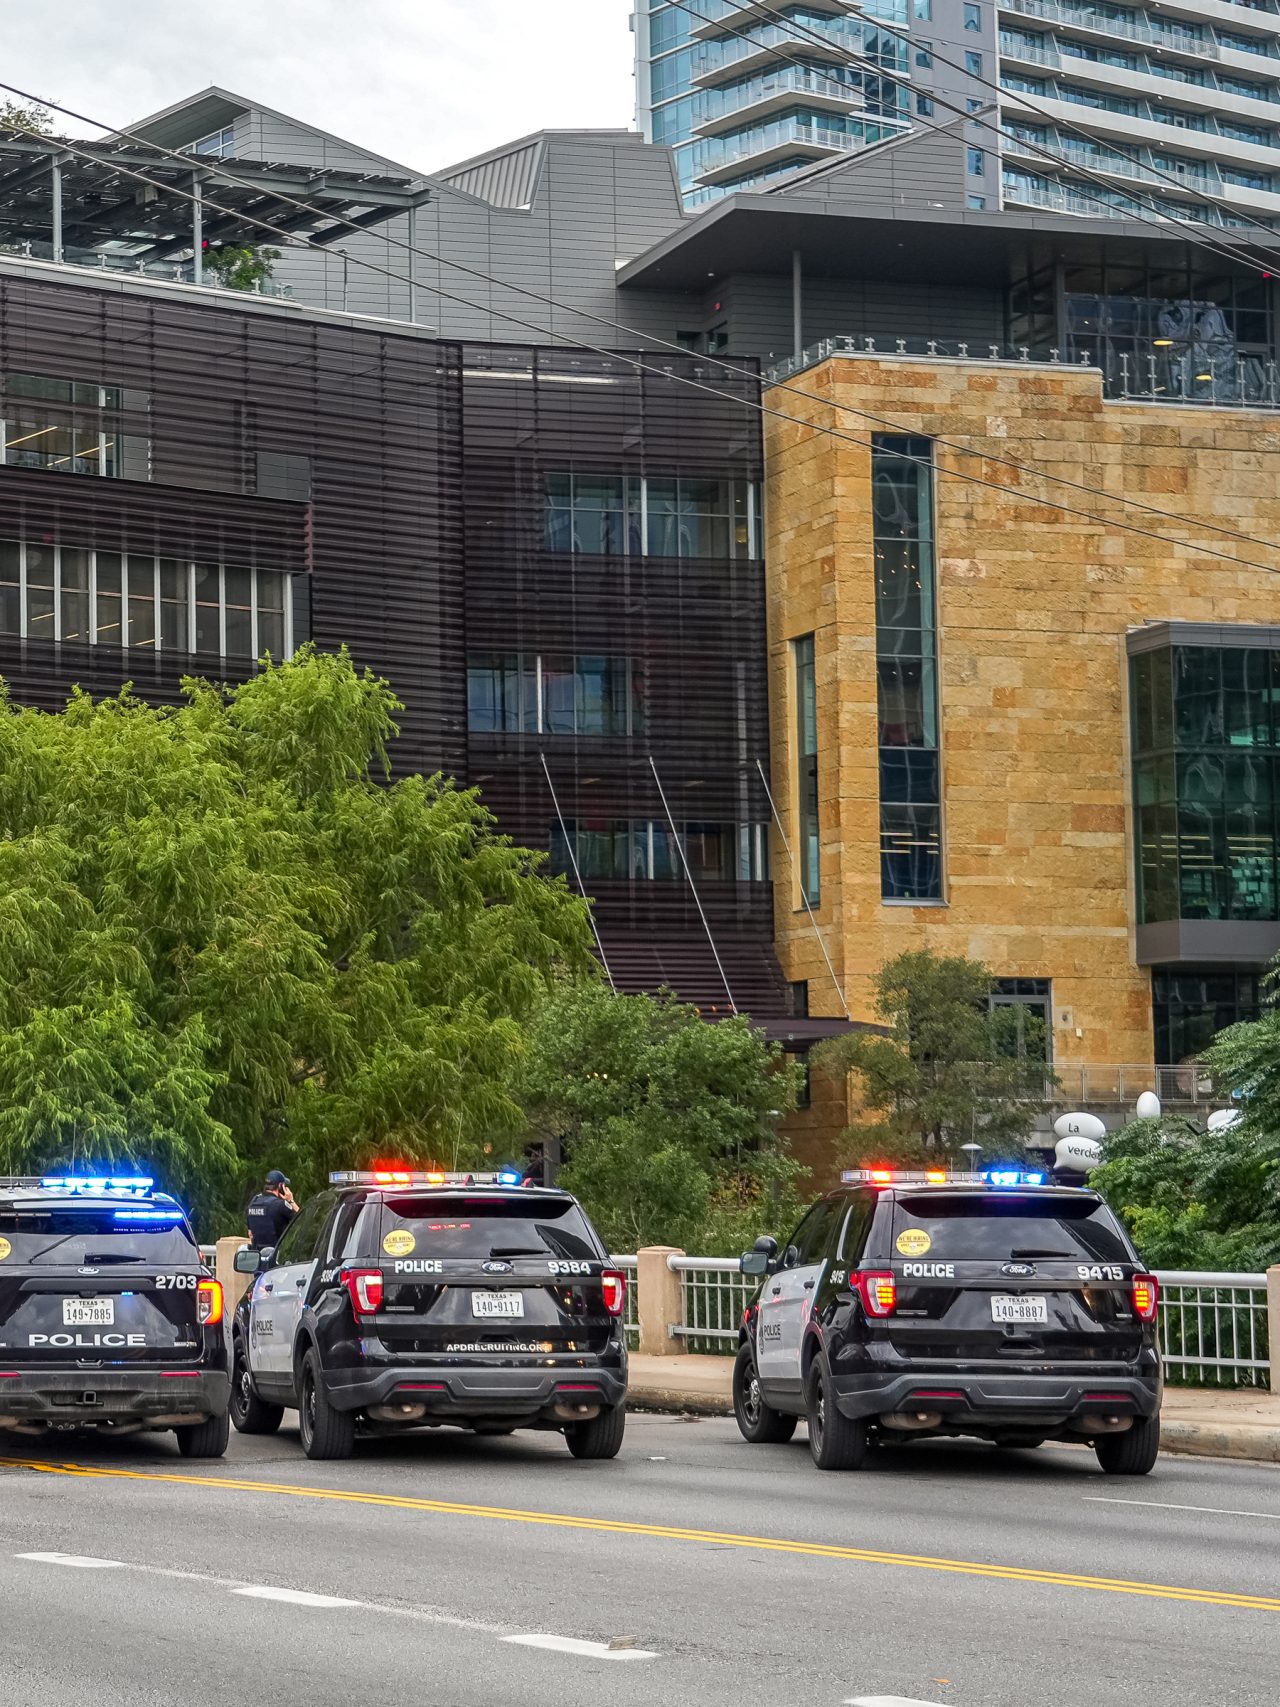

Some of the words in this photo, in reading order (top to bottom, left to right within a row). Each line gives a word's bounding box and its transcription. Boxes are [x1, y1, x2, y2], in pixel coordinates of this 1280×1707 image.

[1068, 1123, 1080, 1133] La
[248, 1208, 265, 1216] POLICE
[395, 1260, 443, 1274] POLICE
[548, 1261, 591, 1274] 9384
[903, 1263, 955, 1278] POLICE
[1076, 1266, 1124, 1280] 9415
[155, 1276, 197, 1289] 2703
[256, 1320, 273, 1333] POLICE
[763, 1323, 781, 1336] POLICE
[28, 1333, 147, 1347] POLICE
